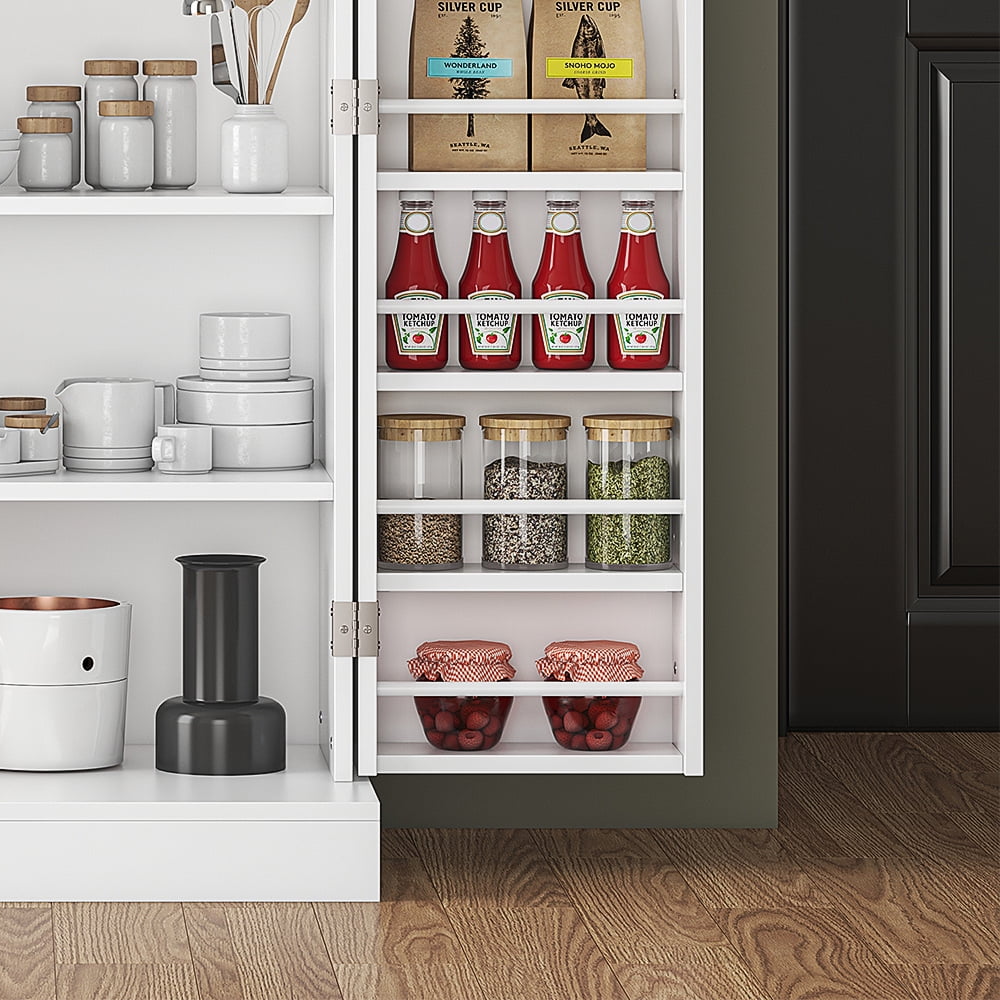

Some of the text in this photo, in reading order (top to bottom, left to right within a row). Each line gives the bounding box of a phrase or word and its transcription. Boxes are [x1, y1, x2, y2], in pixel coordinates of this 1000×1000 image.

[438, 2, 503, 12] SILVER CUP
[555, 2, 621, 11] SILVER CUP
